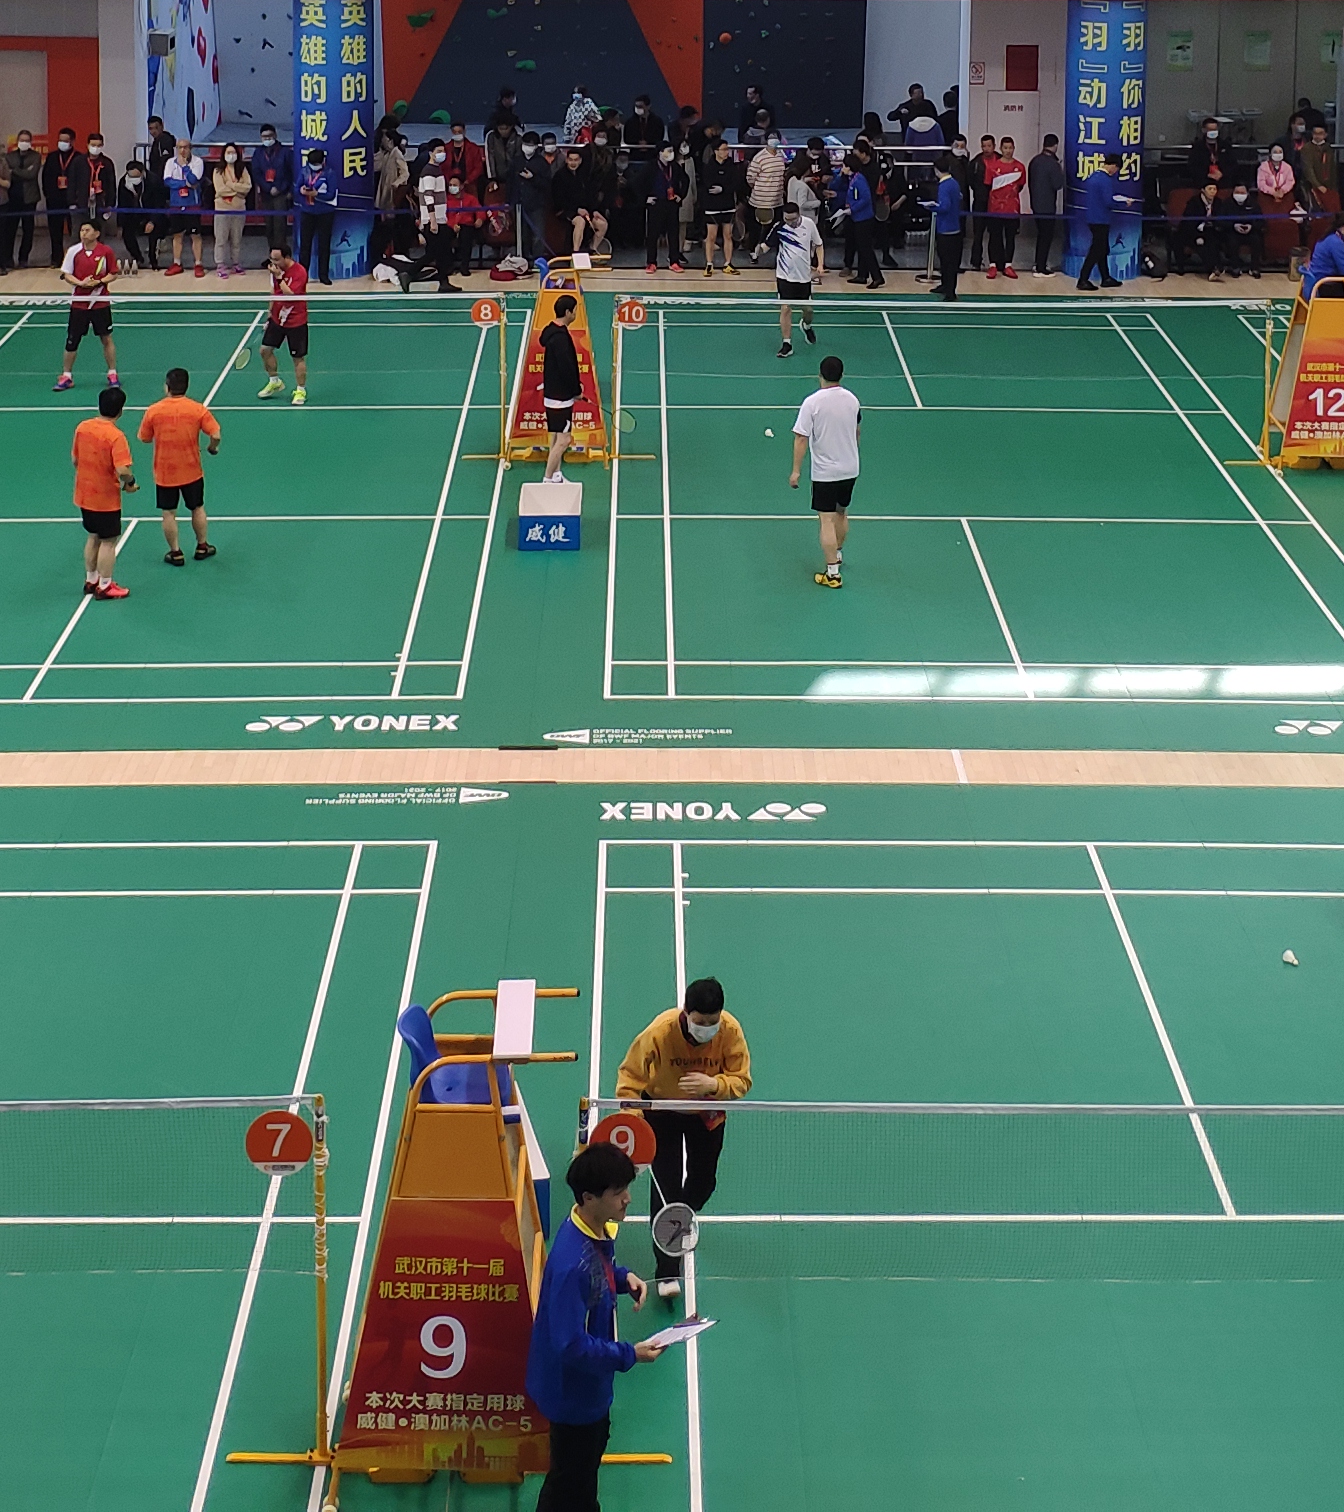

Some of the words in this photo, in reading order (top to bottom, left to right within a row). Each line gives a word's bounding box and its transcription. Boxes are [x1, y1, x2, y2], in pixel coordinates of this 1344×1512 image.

[480, 304, 493, 320] 8
[621, 305, 643, 322] 10
[526, 523, 571, 543] 威健
[329, 714, 460, 732] YONEX
[599, 802, 741, 821] YONEX
[265, 1123, 291, 1157] 7
[609, 1125, 635, 1158] 9
[394, 1256, 504, 1277] 武汉市第十一届
[378, 1281, 519, 1302] 机关职工羽毛球比赛
[419, 1315, 467, 1379] 9
[364, 1392, 526, 1411] 本次大赛指定用球
